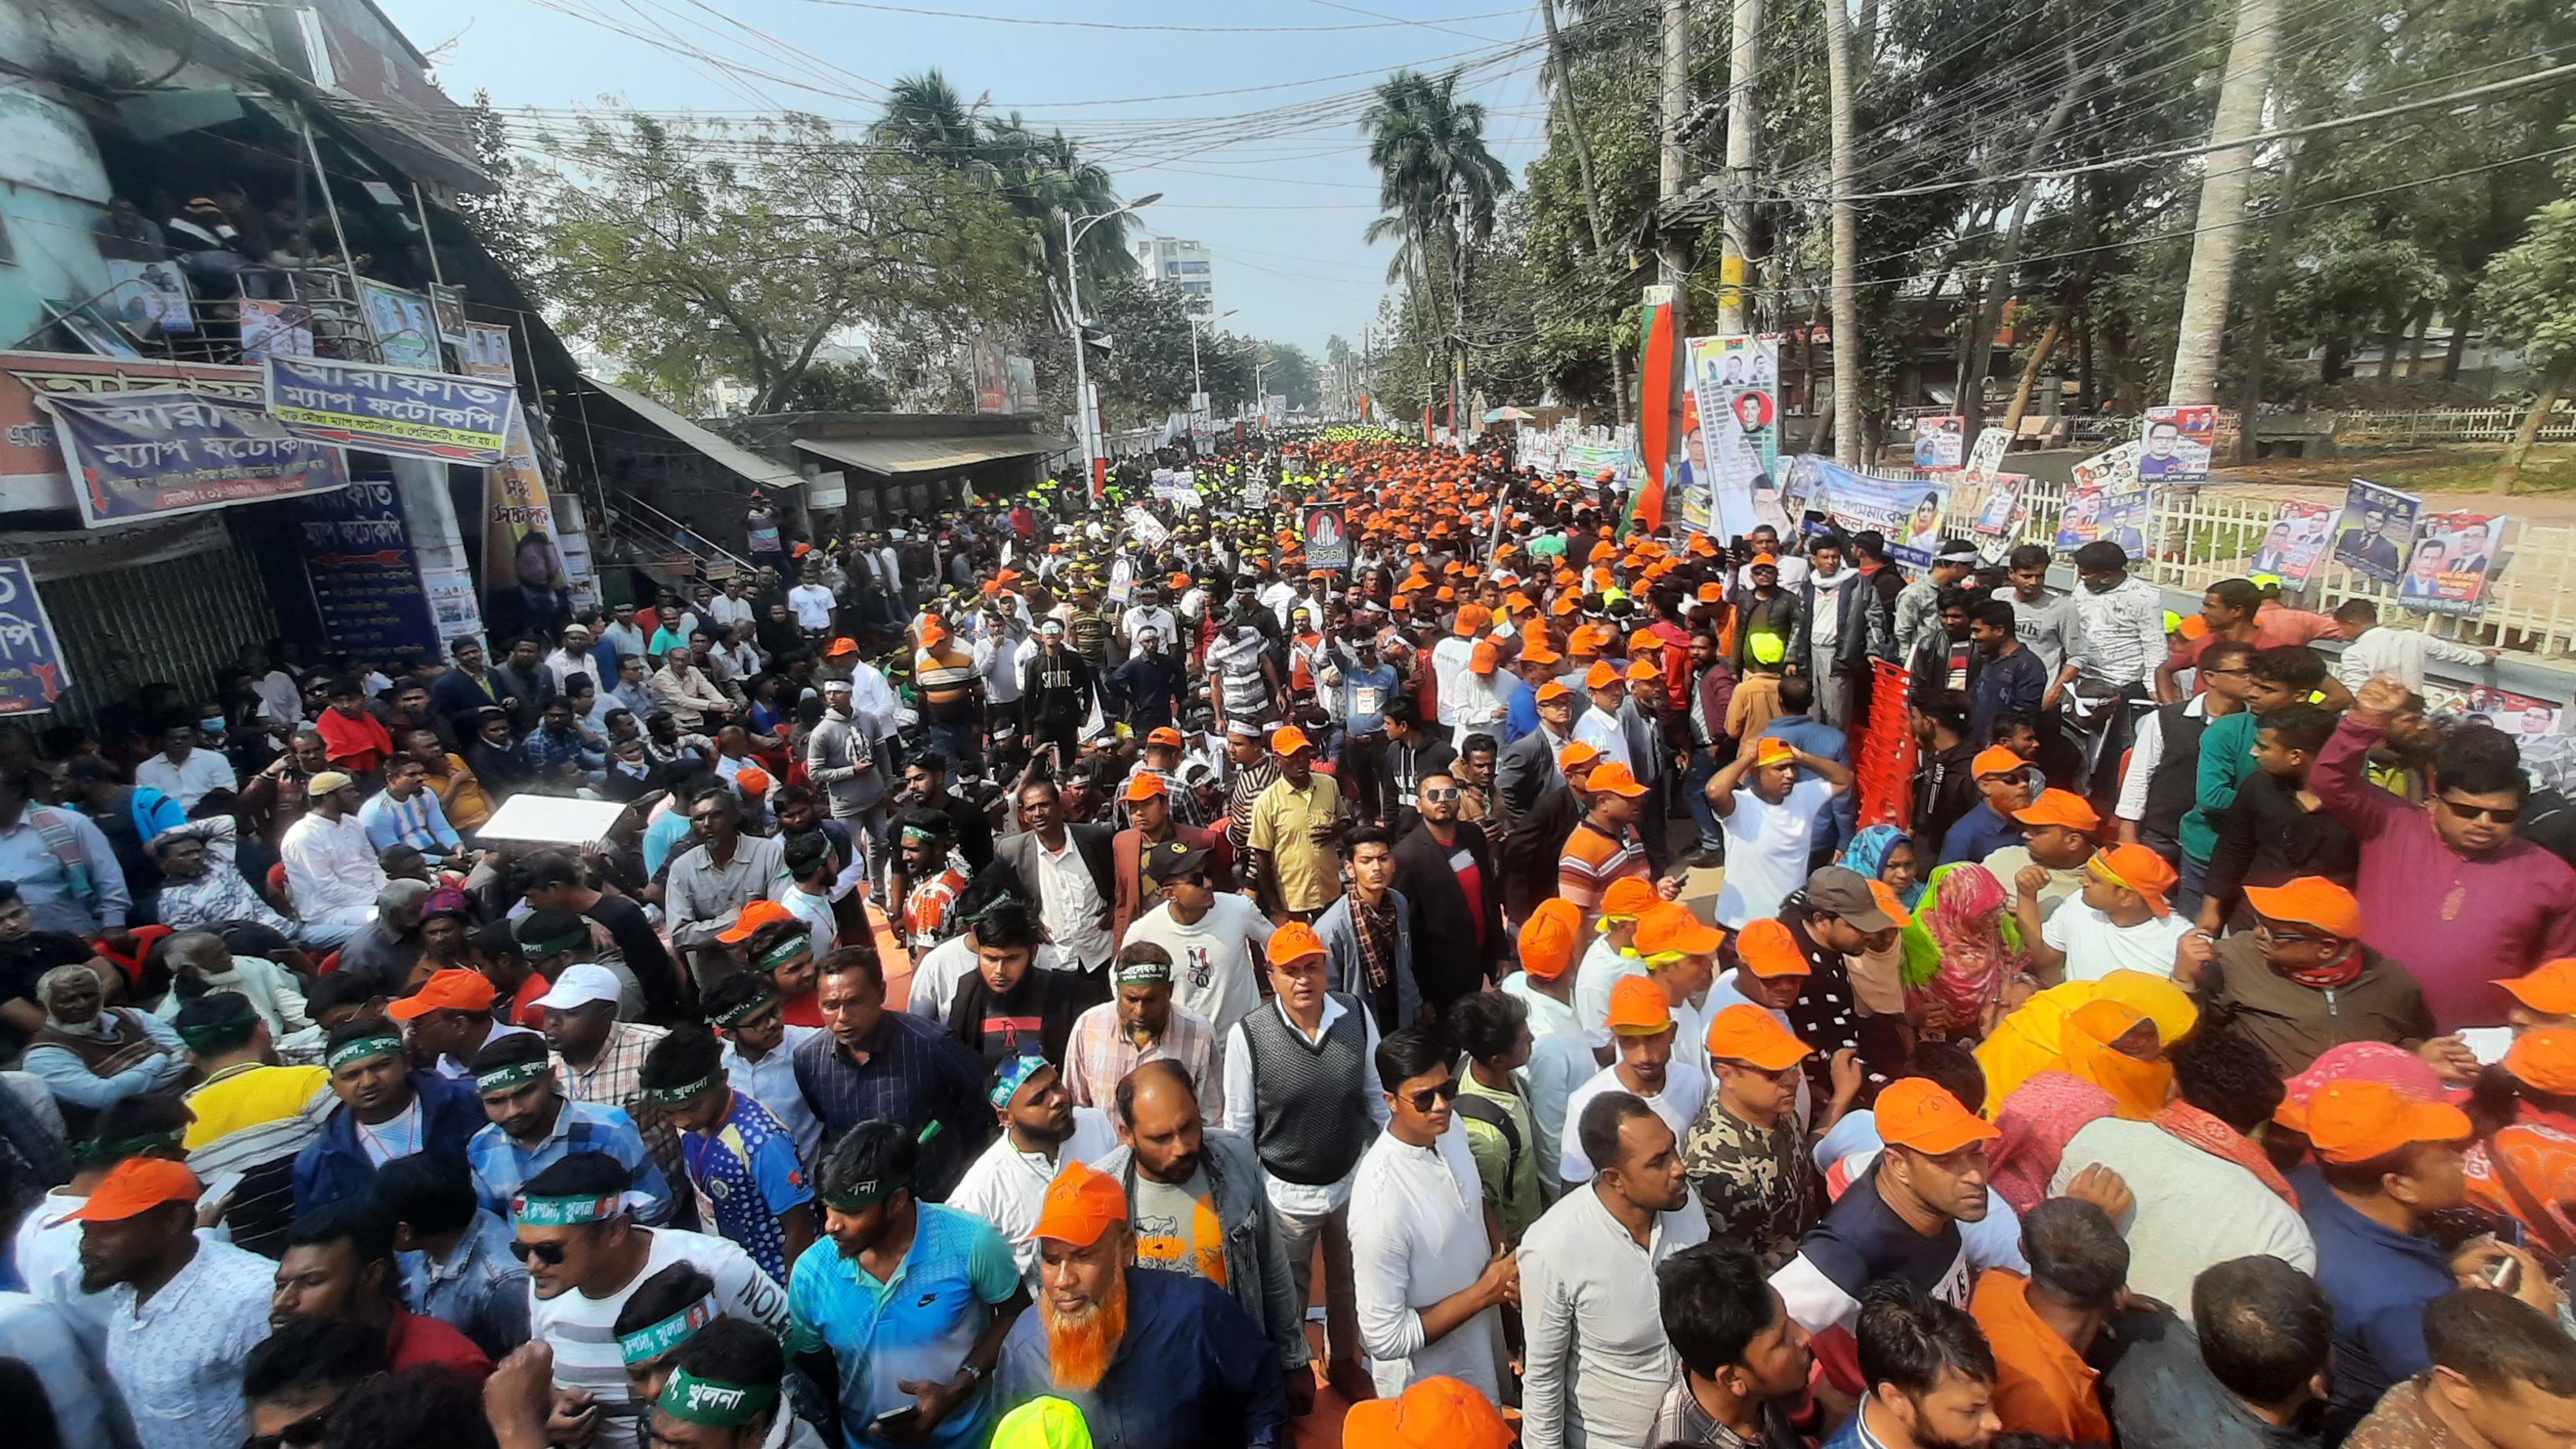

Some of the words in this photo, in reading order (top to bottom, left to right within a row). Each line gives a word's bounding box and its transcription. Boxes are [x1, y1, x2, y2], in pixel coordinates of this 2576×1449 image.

[281, 385, 357, 413] ম্যাপ
[364, 397, 500, 432] ফটোকপি
[95, 439, 190, 468] ম্যাপ
[1843, 499, 1910, 526] গণসমাবেশ
[1042, 670, 1072, 689] STRIDE
[687, 1383, 747, 1411] খুলনা
